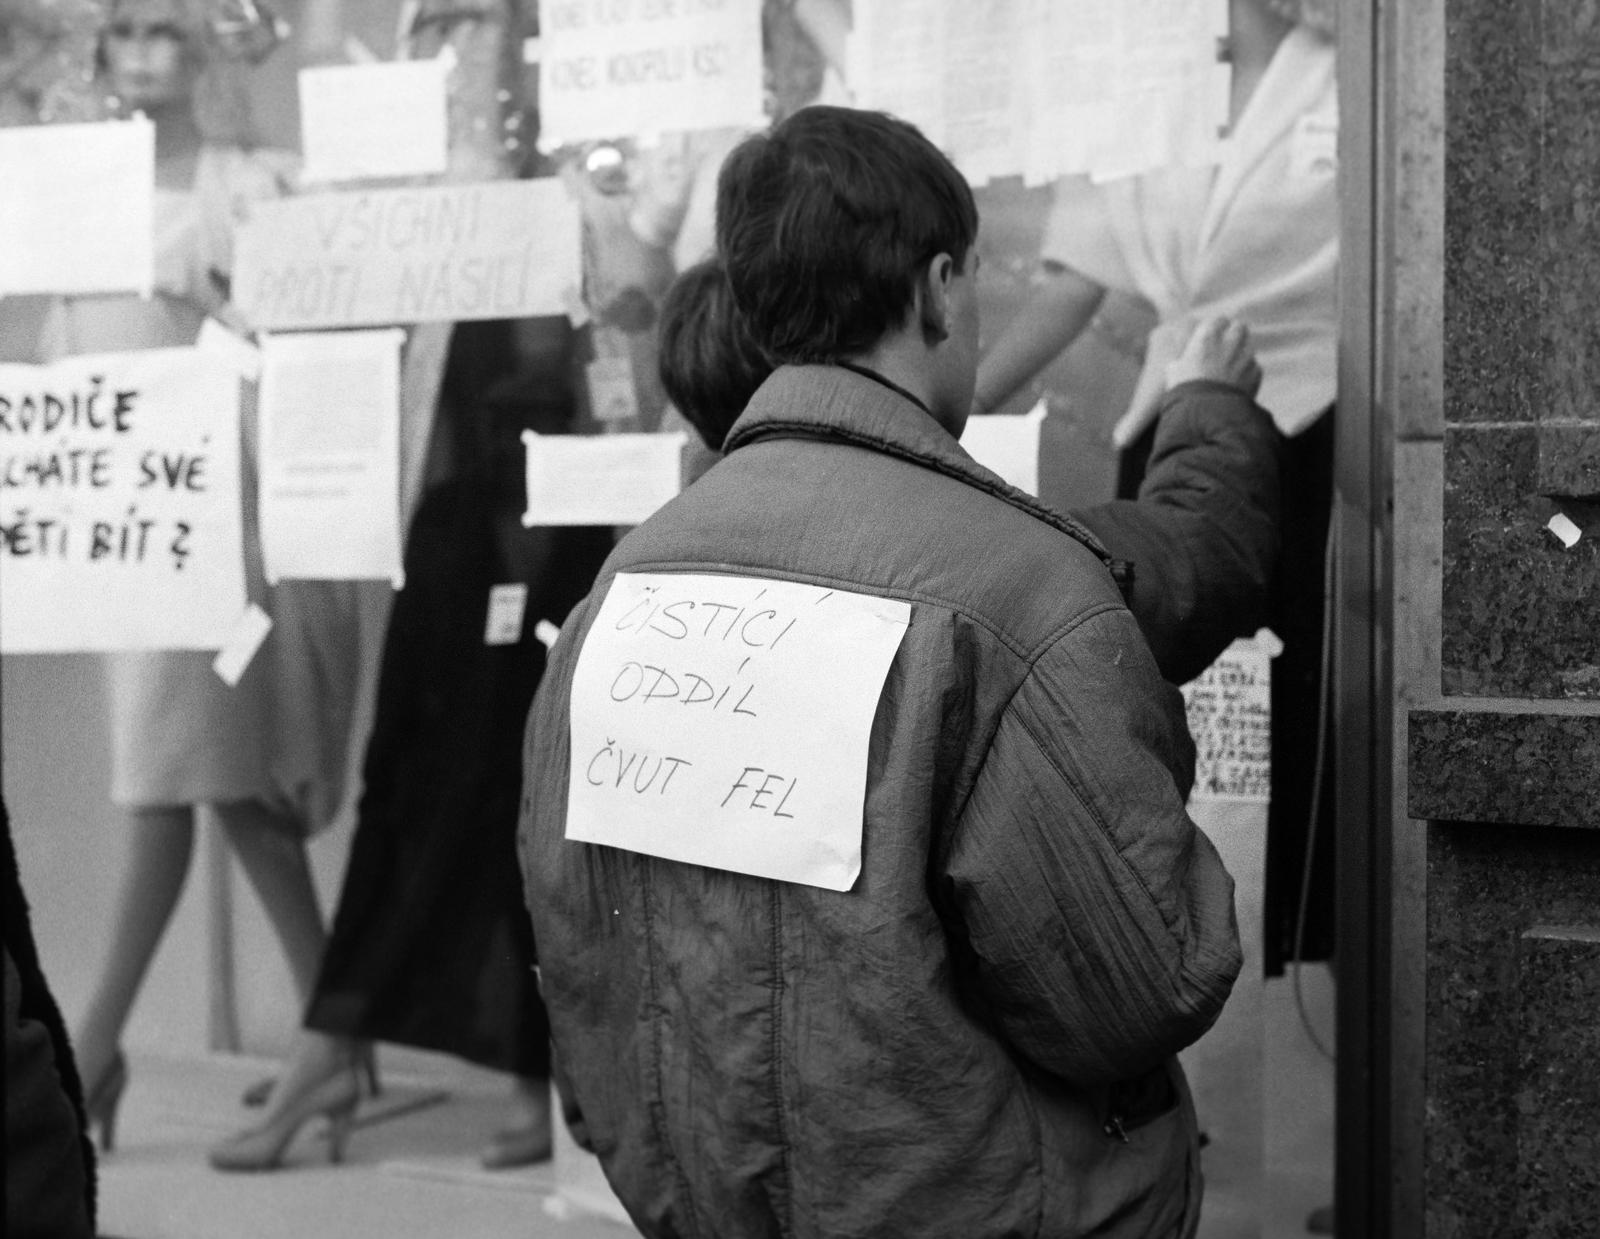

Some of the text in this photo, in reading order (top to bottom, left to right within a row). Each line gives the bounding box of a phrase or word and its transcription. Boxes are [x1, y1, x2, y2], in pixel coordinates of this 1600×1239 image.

[313, 190, 481, 251] VŠICHNI
[254, 262, 362, 320] PROTI
[0, 435, 208, 491] CHÁTE SVÉ
[610, 657, 757, 716] ODDÍL
[587, 737, 795, 818] ČVUT FEL
